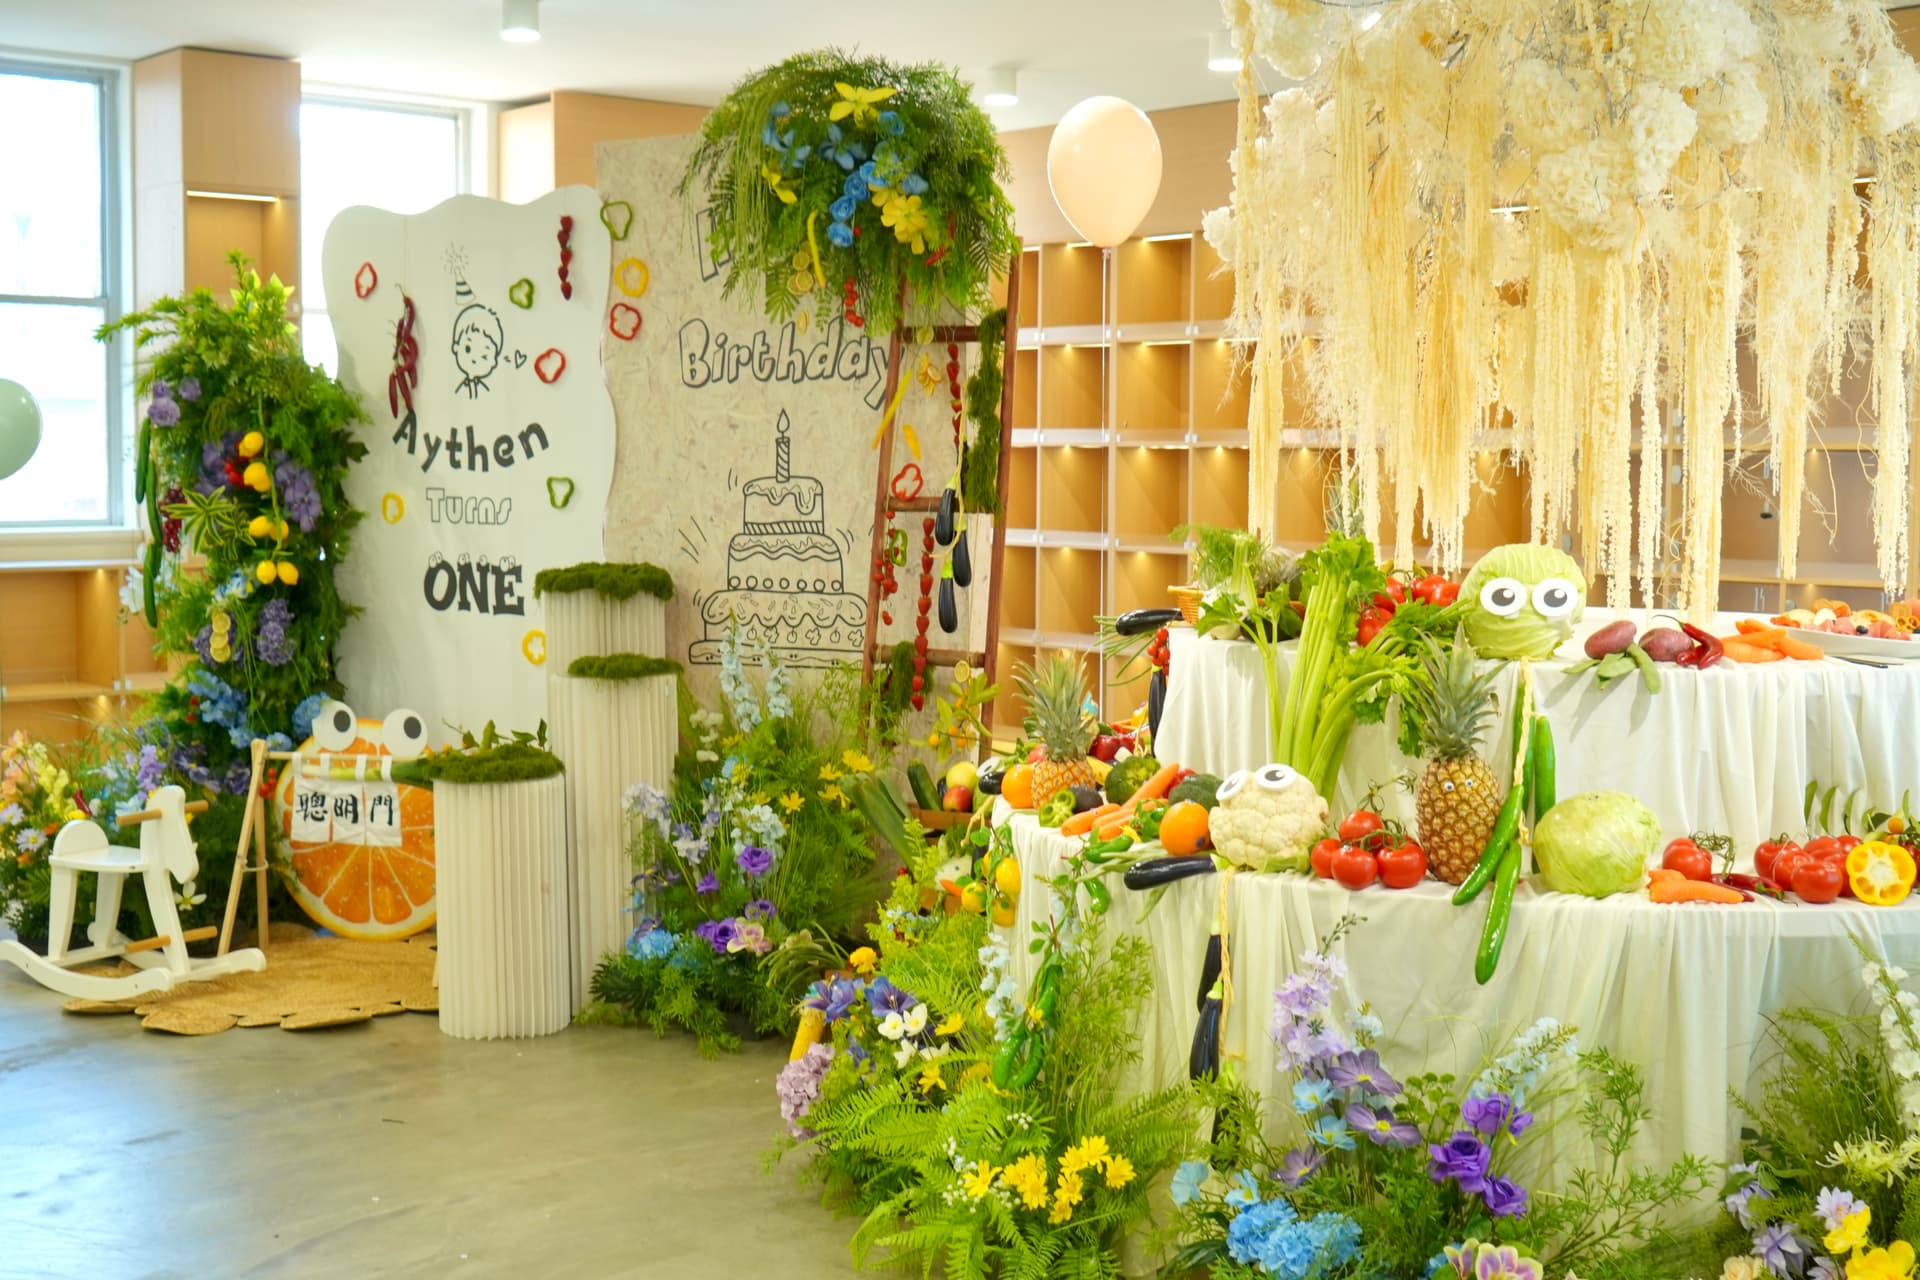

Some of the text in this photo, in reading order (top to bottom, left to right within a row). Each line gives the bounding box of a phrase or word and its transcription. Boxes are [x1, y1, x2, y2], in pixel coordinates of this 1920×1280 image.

[680, 317, 905, 410] Birthday
[393, 409, 549, 473] Aythen
[426, 488, 512, 525] Turns
[424, 558, 525, 616] ONE
[296, 791, 393, 826] 聰明門
